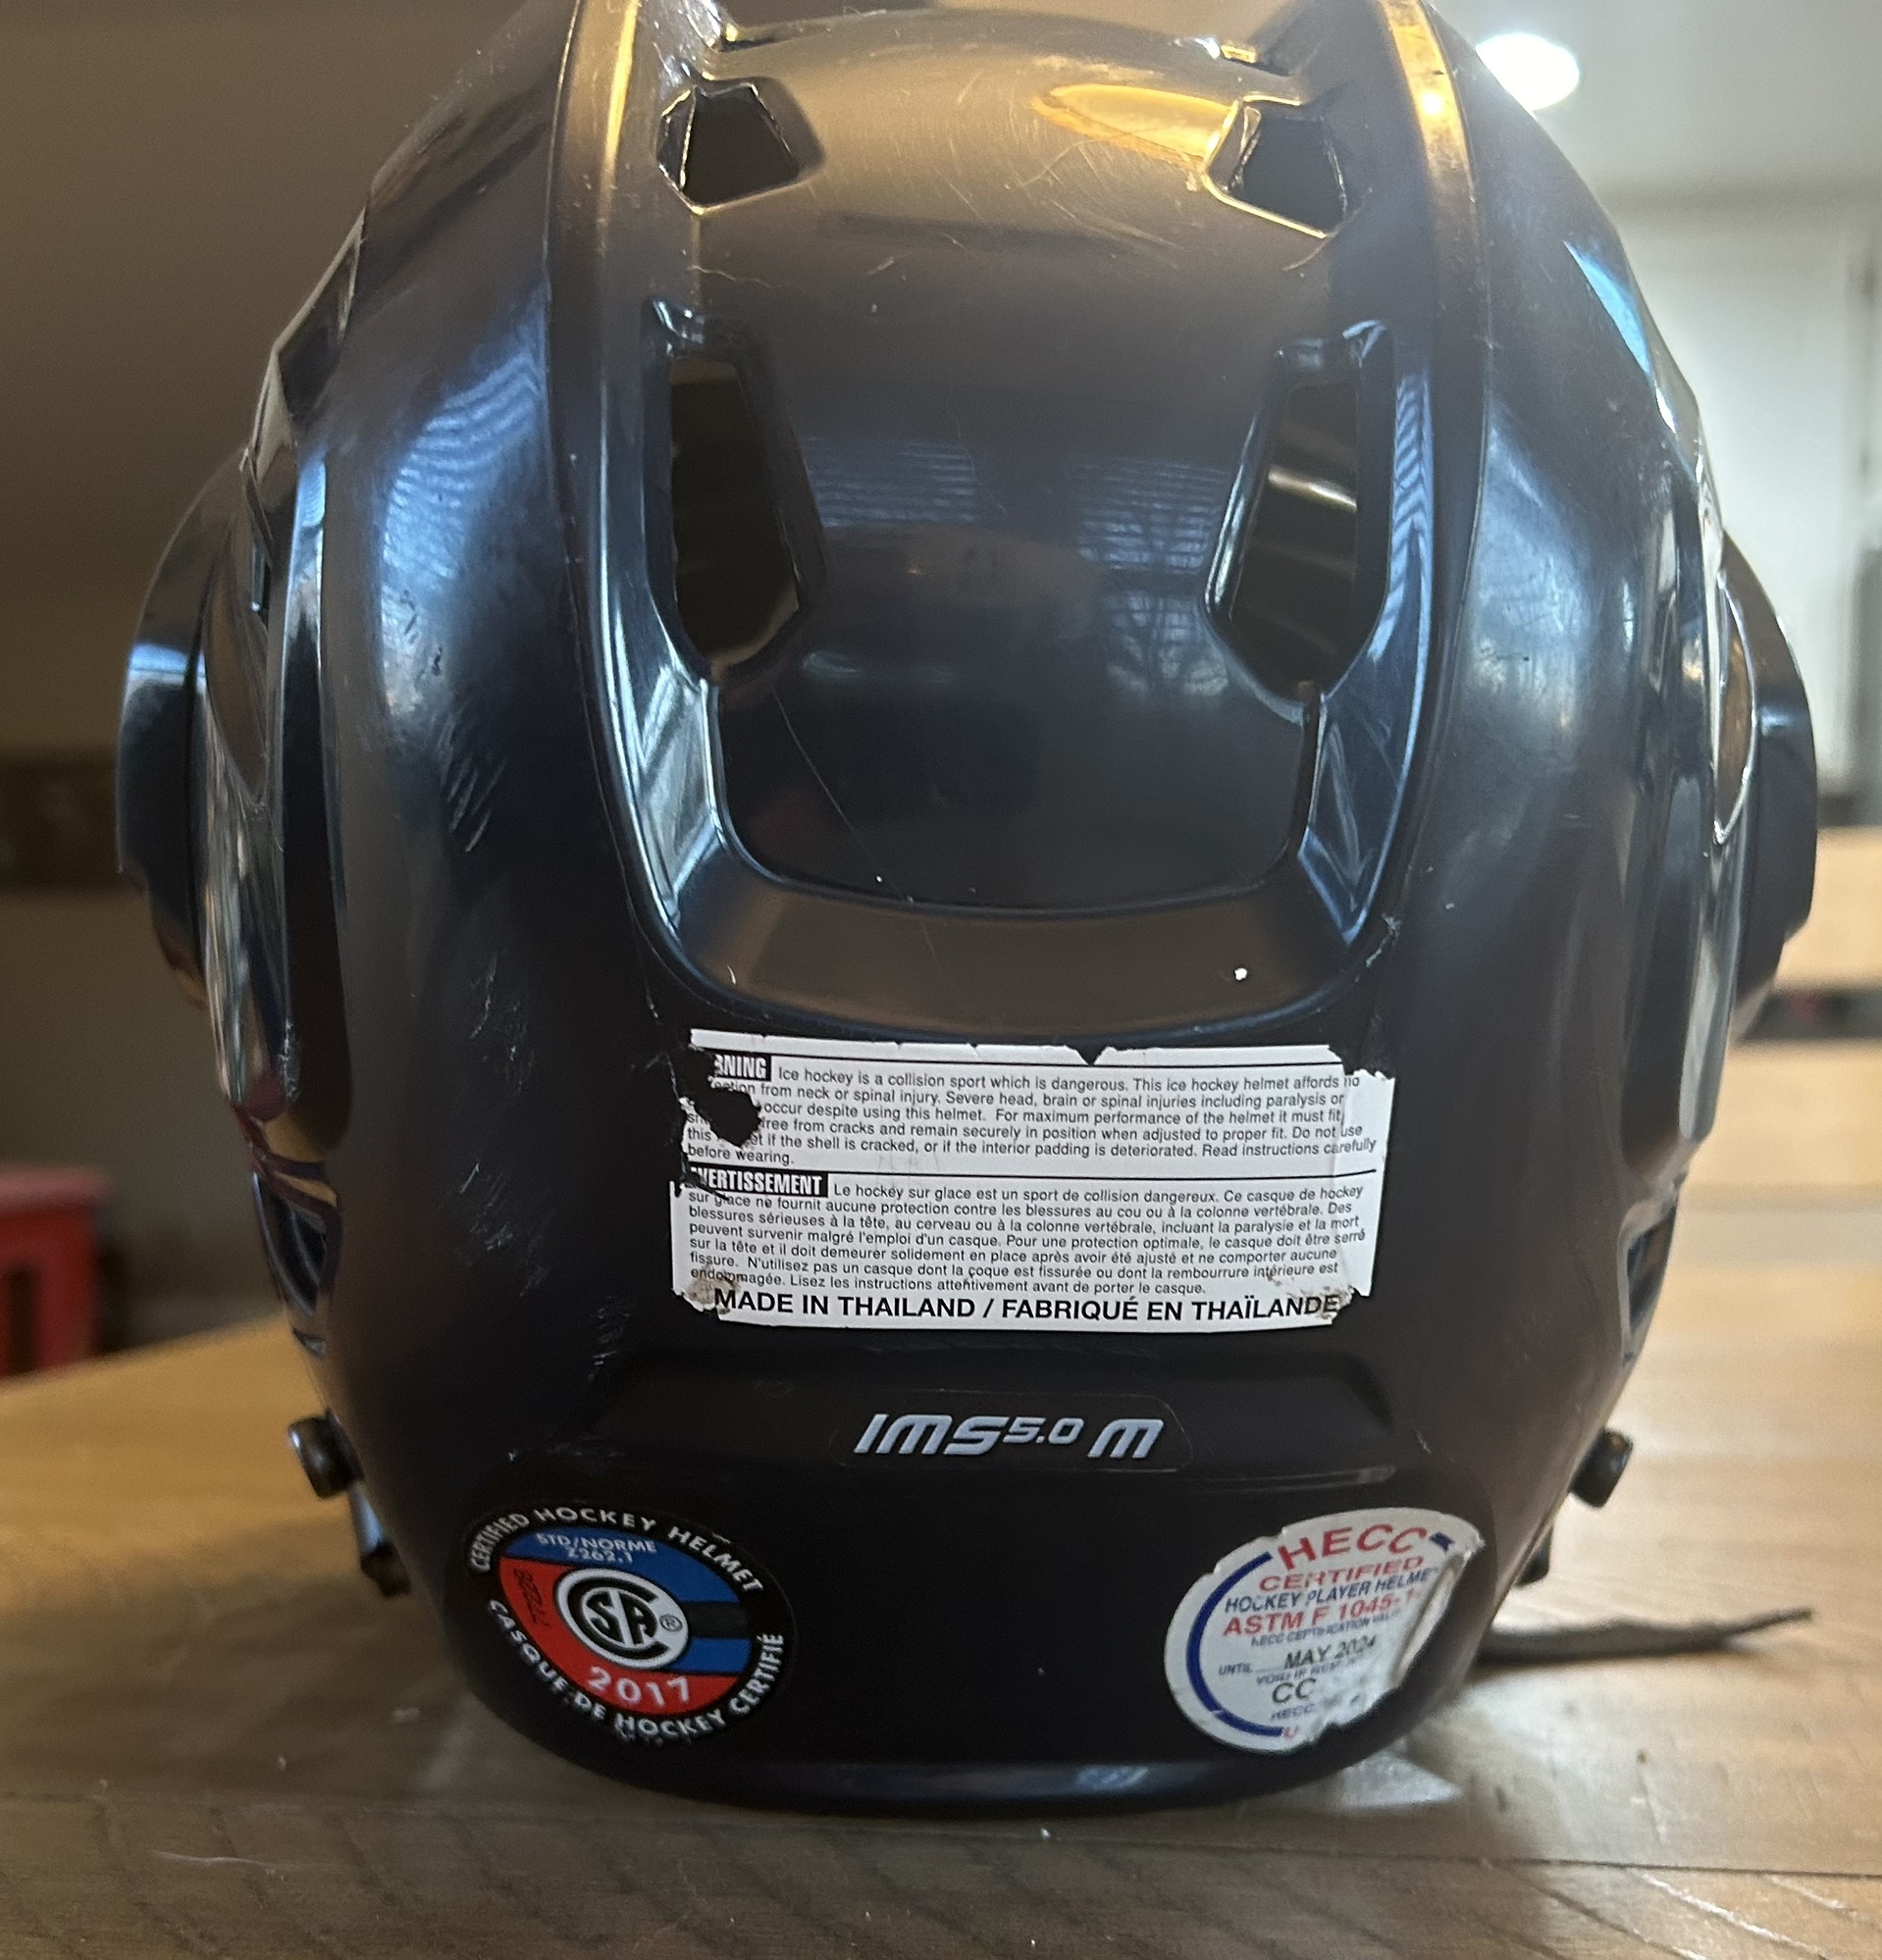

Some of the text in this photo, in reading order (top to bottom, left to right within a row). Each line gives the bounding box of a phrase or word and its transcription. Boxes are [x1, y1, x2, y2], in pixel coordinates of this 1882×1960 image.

[778, 1067, 799, 1080] Ice
[804, 1068, 854, 1085] hockey
[887, 1071, 945, 1085] collision
[950, 1074, 985, 1090] sport
[989, 1075, 1030, 1088] which
[1050, 1077, 1128, 1093] dangerous.
[1134, 1078, 1162, 1091] This
[1166, 1079, 1186, 1091] ice
[1190, 1078, 1239, 1094] hockey
[1242, 1077, 1289, 1090] helmet
[1293, 1075, 1338, 1089] affords
[759, 1082, 792, 1096] from
[797, 1084, 830, 1098] neck
[853, 1087, 895, 1104] spinal
[899, 1090, 941, 1106] injury.
[944, 1091, 994, 1105] Severe
[999, 1093, 1037, 1109] head,
[1042, 1094, 1077, 1107] brain
[1100, 1095, 1142, 1109] spinal
[1146, 1095, 1196, 1109] injuries
[1200, 1095, 1262, 1109] including
[1266, 1093, 1326, 1109] paralysis
[762, 1103, 1324, 1126] occur despite using this helmet. For maximum performance helmet must
[686, 1126, 1376, 1159] this shell cracked, interior padding deteriorated. Read instructions carefully
[793, 1118, 824, 1131] from
[828, 1119, 875, 1133] cracks
[910, 1122, 958, 1135] remain
[962, 1123, 1021, 1140] securely
[1042, 1126, 1096, 1141] position
[1100, 1127, 1137, 1139] when
[1142, 1127, 1201, 1142] adjusted
[1222, 1130, 1268, 1142] proper
[687, 1143, 795, 1166] before wearing.
[776, 1195, 820, 1209] fournit
[824, 1200, 877, 1212] aucune
[880, 1200, 950, 1216] protection
[953, 1202, 997, 1215] contre
[1024, 1204, 1091, 1216] blessures
[1195, 1205, 1249, 1216] colonne
[1327, 1202, 1352, 1214] Des
[855, 1184, 904, 1200] hockey
[934, 1187, 972, 1203] glace
[1022, 1188, 1059, 1204] sport
[1083, 1189, 1138, 1201] collision
[1143, 1189, 1219, 1204] dangereux.
[1246, 1190, 1295, 1204] casque
[1319, 1185, 1363, 1202] hockey
[688, 1206, 754, 1221] blessures
[758, 1210, 825, 1225] sérieuses
[859, 1214, 889, 1230] tête,
[915, 1219, 970, 1230] cerveau
[1025, 1219, 1079, 1232] colonne
[1161, 1220, 1215, 1232] incluant
[1233, 1218, 1293, 1234] paralysie
[1330, 1216, 1358, 1229] mort
[687, 1221, 743, 1239] peuvent
[747, 1224, 803, 1239] survenir
[807, 1227, 854, 1245] malgré
[859, 1230, 911, 1247] l'emploi
[915, 1232, 944, 1245] d'un
[948, 1236, 1001, 1249] casque.
[1005, 1235, 1038, 1247] Pour
[1071, 1236, 1138, 1251] protection
[1224, 1237, 1273, 1250] casque
[1276, 1233, 1301, 1246] doit
[1304, 1232, 1330, 1245] être
[1333, 1230, 1366, 1244] serré
[689, 1252, 1315, 1278] fissure. N'utilisez casque dont fissurée dont rembourrure intérieure
[731, 1238, 1336, 1265] tête doit demeurer solidement place après avoir ajusté comporter aucune
[789, 1272, 825, 1285] Lisez
[854, 1274, 932, 1289] instructions
[1031, 1279, 1070, 1292] avant
[1093, 1280, 1134, 1295] porter
[1154, 1283, 1206, 1295] casque.
[712, 1292, 1342, 1320] MADE IN THAILAND FABRIQUÉ EN THAÏLANDE
[1087, 1418, 1165, 1459] M
[468, 1506, 764, 1593] CERTIFIED HOCKEY HELMET
[536, 1533, 657, 1553] STD/NORME
[566, 1547, 634, 1565] Z262.1
[1277, 1523, 1429, 1570] HECC
[1305, 1581, 1371, 1608] PLAYER
[1223, 1610, 1303, 1636] ASTM
[1311, 1605, 1332, 1625] F
[489, 1599, 785, 1741] CASQUE DE HOCKEY CERTIFIÉ
[1283, 1644, 1333, 1670] MAY
[588, 1666, 691, 1707] 2017
[1272, 1677, 1317, 1705] CC
